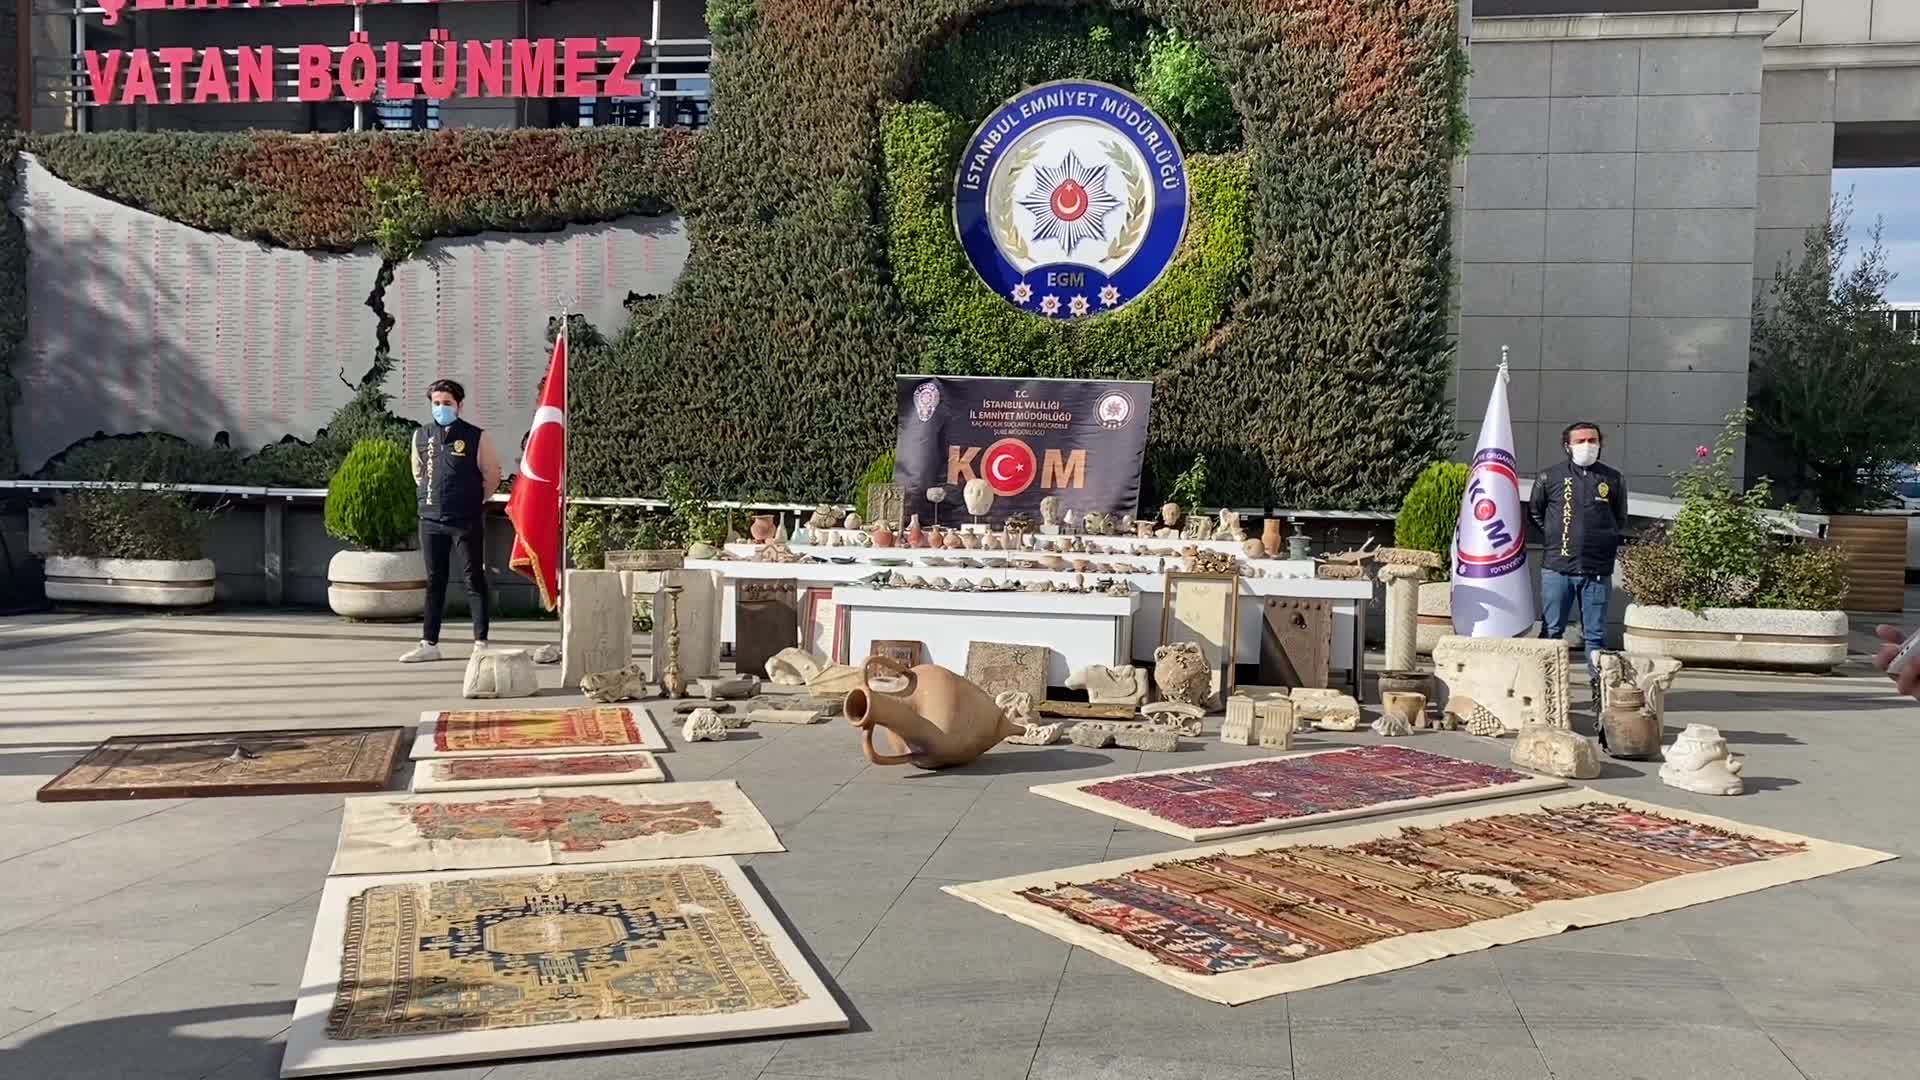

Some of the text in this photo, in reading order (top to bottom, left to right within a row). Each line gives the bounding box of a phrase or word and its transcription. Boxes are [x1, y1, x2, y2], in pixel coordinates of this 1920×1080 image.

[85, 28, 643, 105] VATAN BÖLÜNMEZ
[962, 88, 1178, 191] İSTANBUL EMNİYET MÜDÜRLÜĞÜ
[1047, 272, 1084, 288] EGM
[1014, 390, 1030, 398] T.C.
[983, 399, 1060, 410] İSTANBUL VALİLİĞİ
[969, 408, 1072, 421] İL EMNİYET MÜDÜRLÜĞÜ
[1468, 478, 1512, 549] KOM
